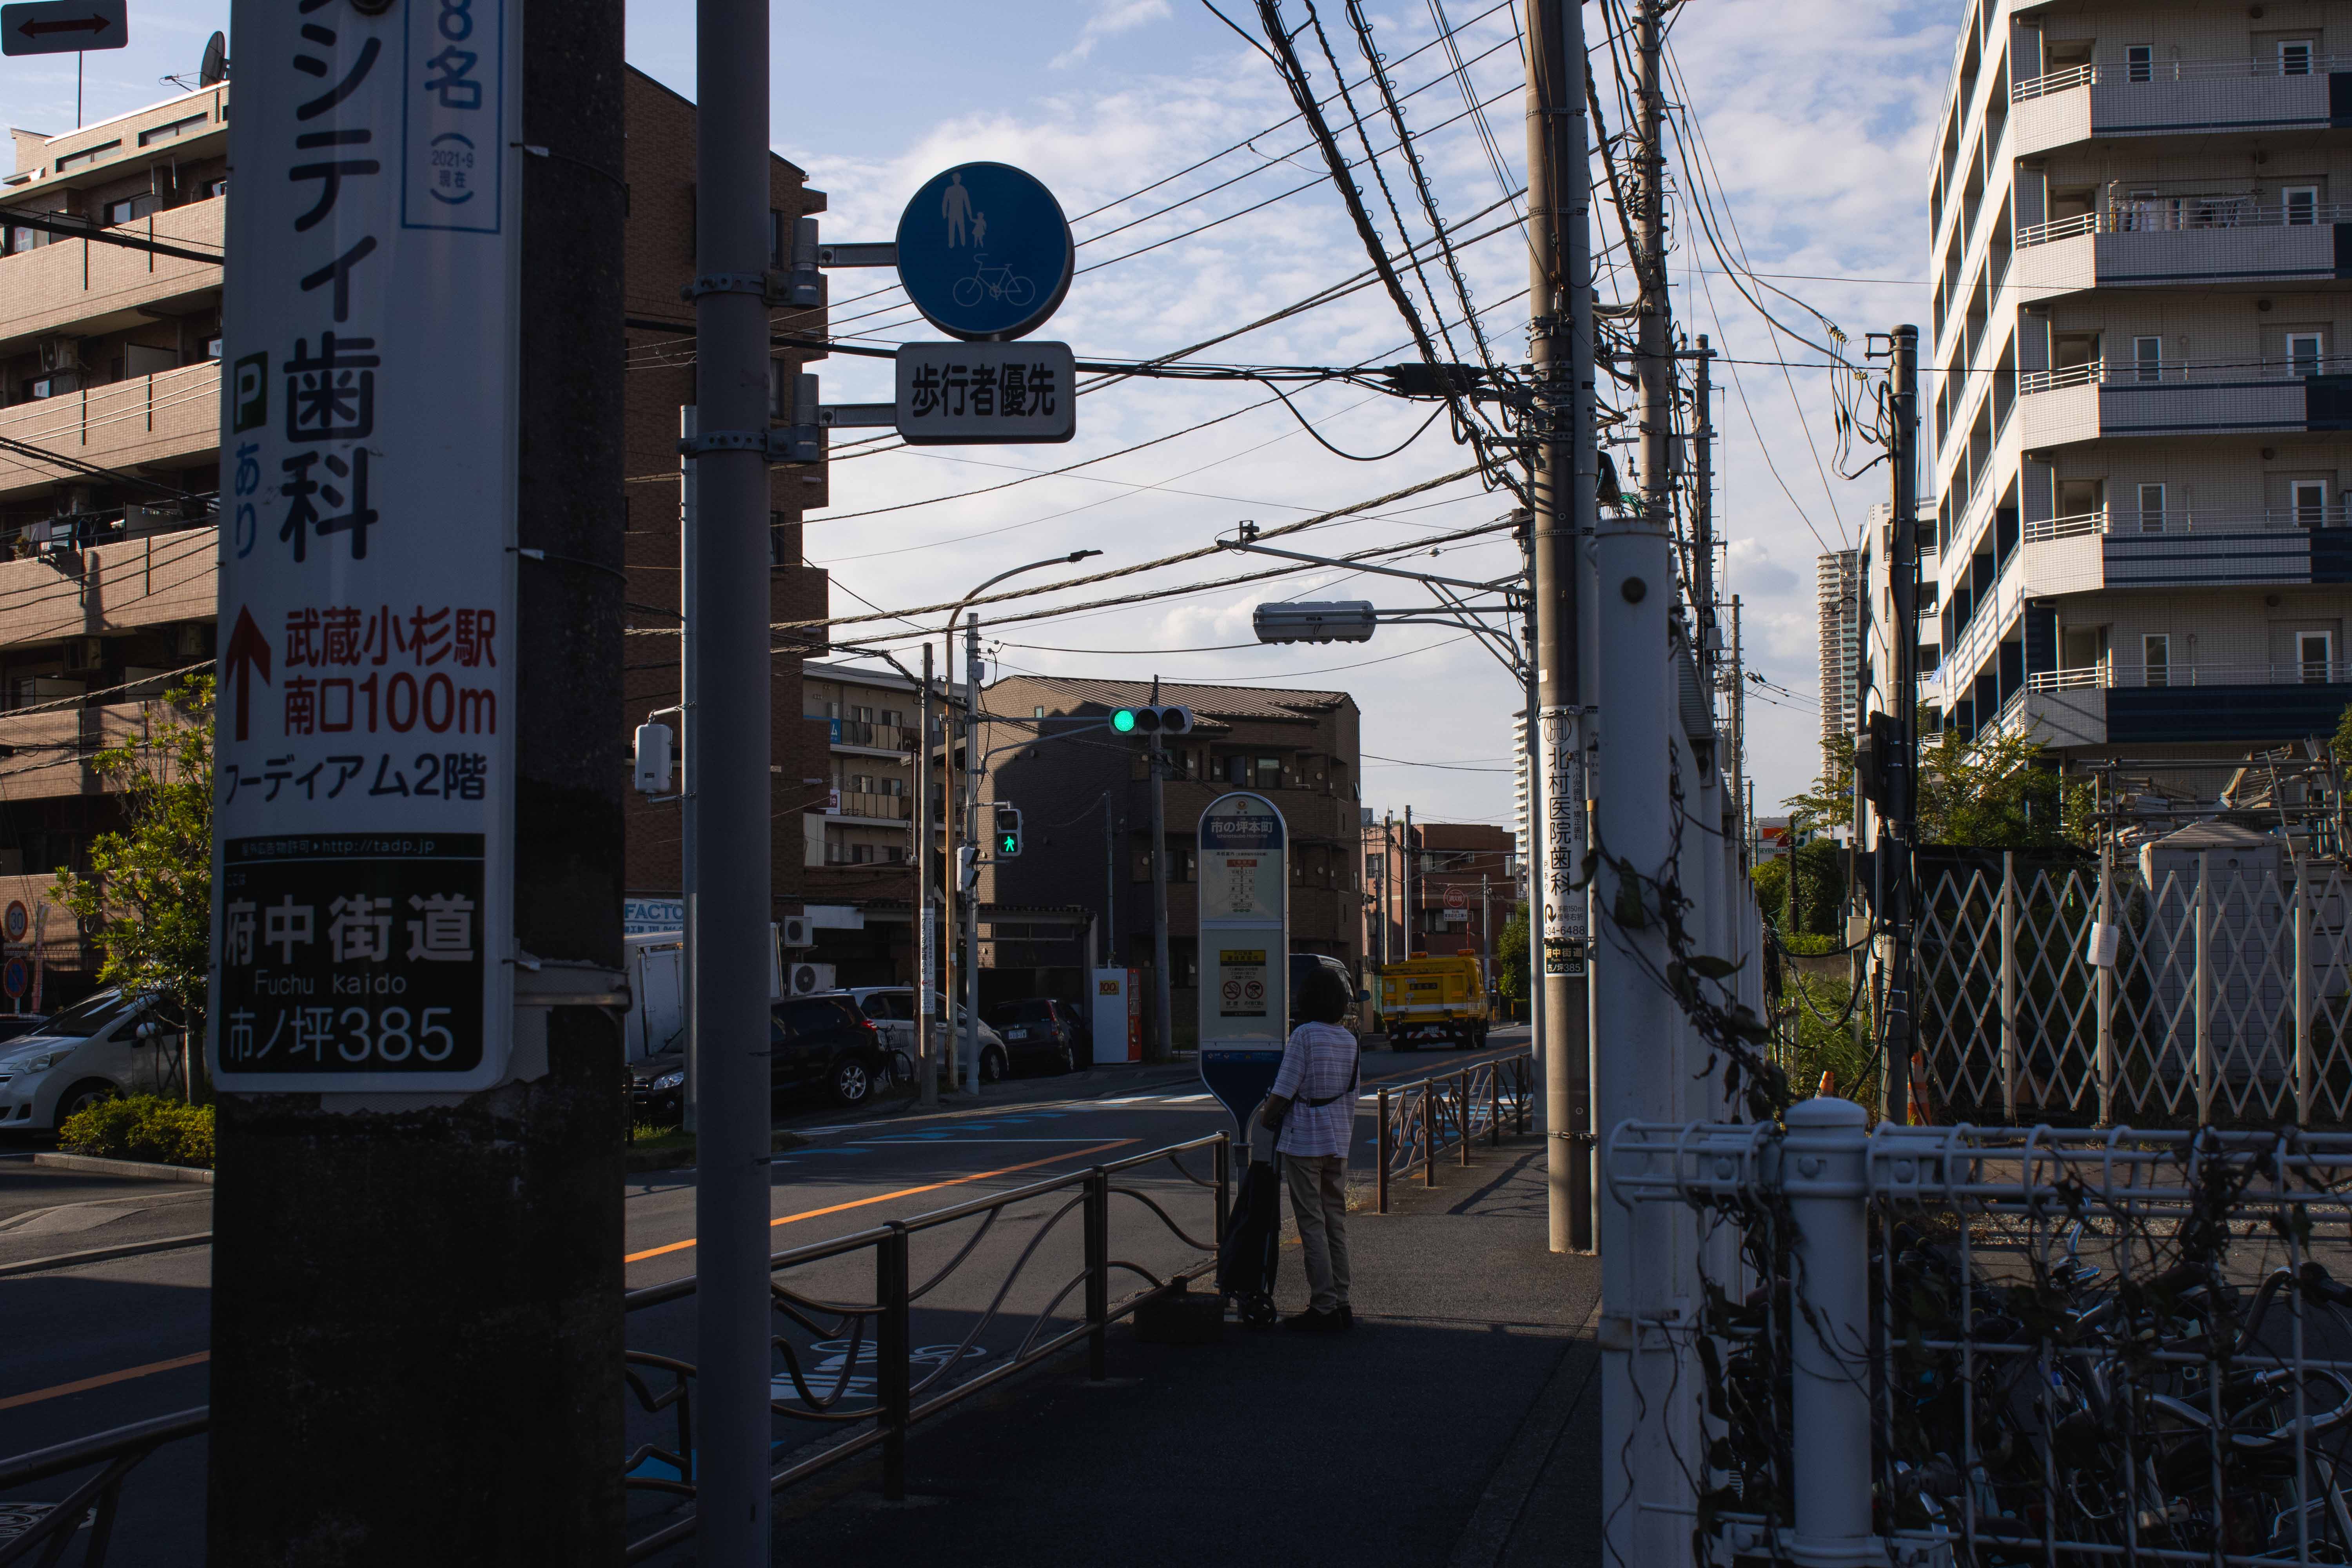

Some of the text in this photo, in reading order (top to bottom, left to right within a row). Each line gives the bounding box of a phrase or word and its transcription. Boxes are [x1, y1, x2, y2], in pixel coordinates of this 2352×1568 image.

[439, 171, 466, 188] 現在
[279, 0, 382, 563] シティ歯科
[912, 363, 1055, 417] 歩行者優先
[285, 605, 496, 667] 武蔵小杉駅
[284, 672, 496, 736] 南口100m
[1210, 822, 1274, 833] 市の坪本町
[1548, 747, 1572, 895] 北村医院歯科
[11, 912, 23, 929] 30
[225, 893, 475, 966] 府中街道
[624, 904, 684, 919] FACTO
[1546, 947, 1584, 958] 府中街道
[1547, 964, 1581, 972] 市ノ坪385
[255, 970, 407, 995] Fuchu kaido
[229, 1005, 454, 1062] 市ノ坪385
